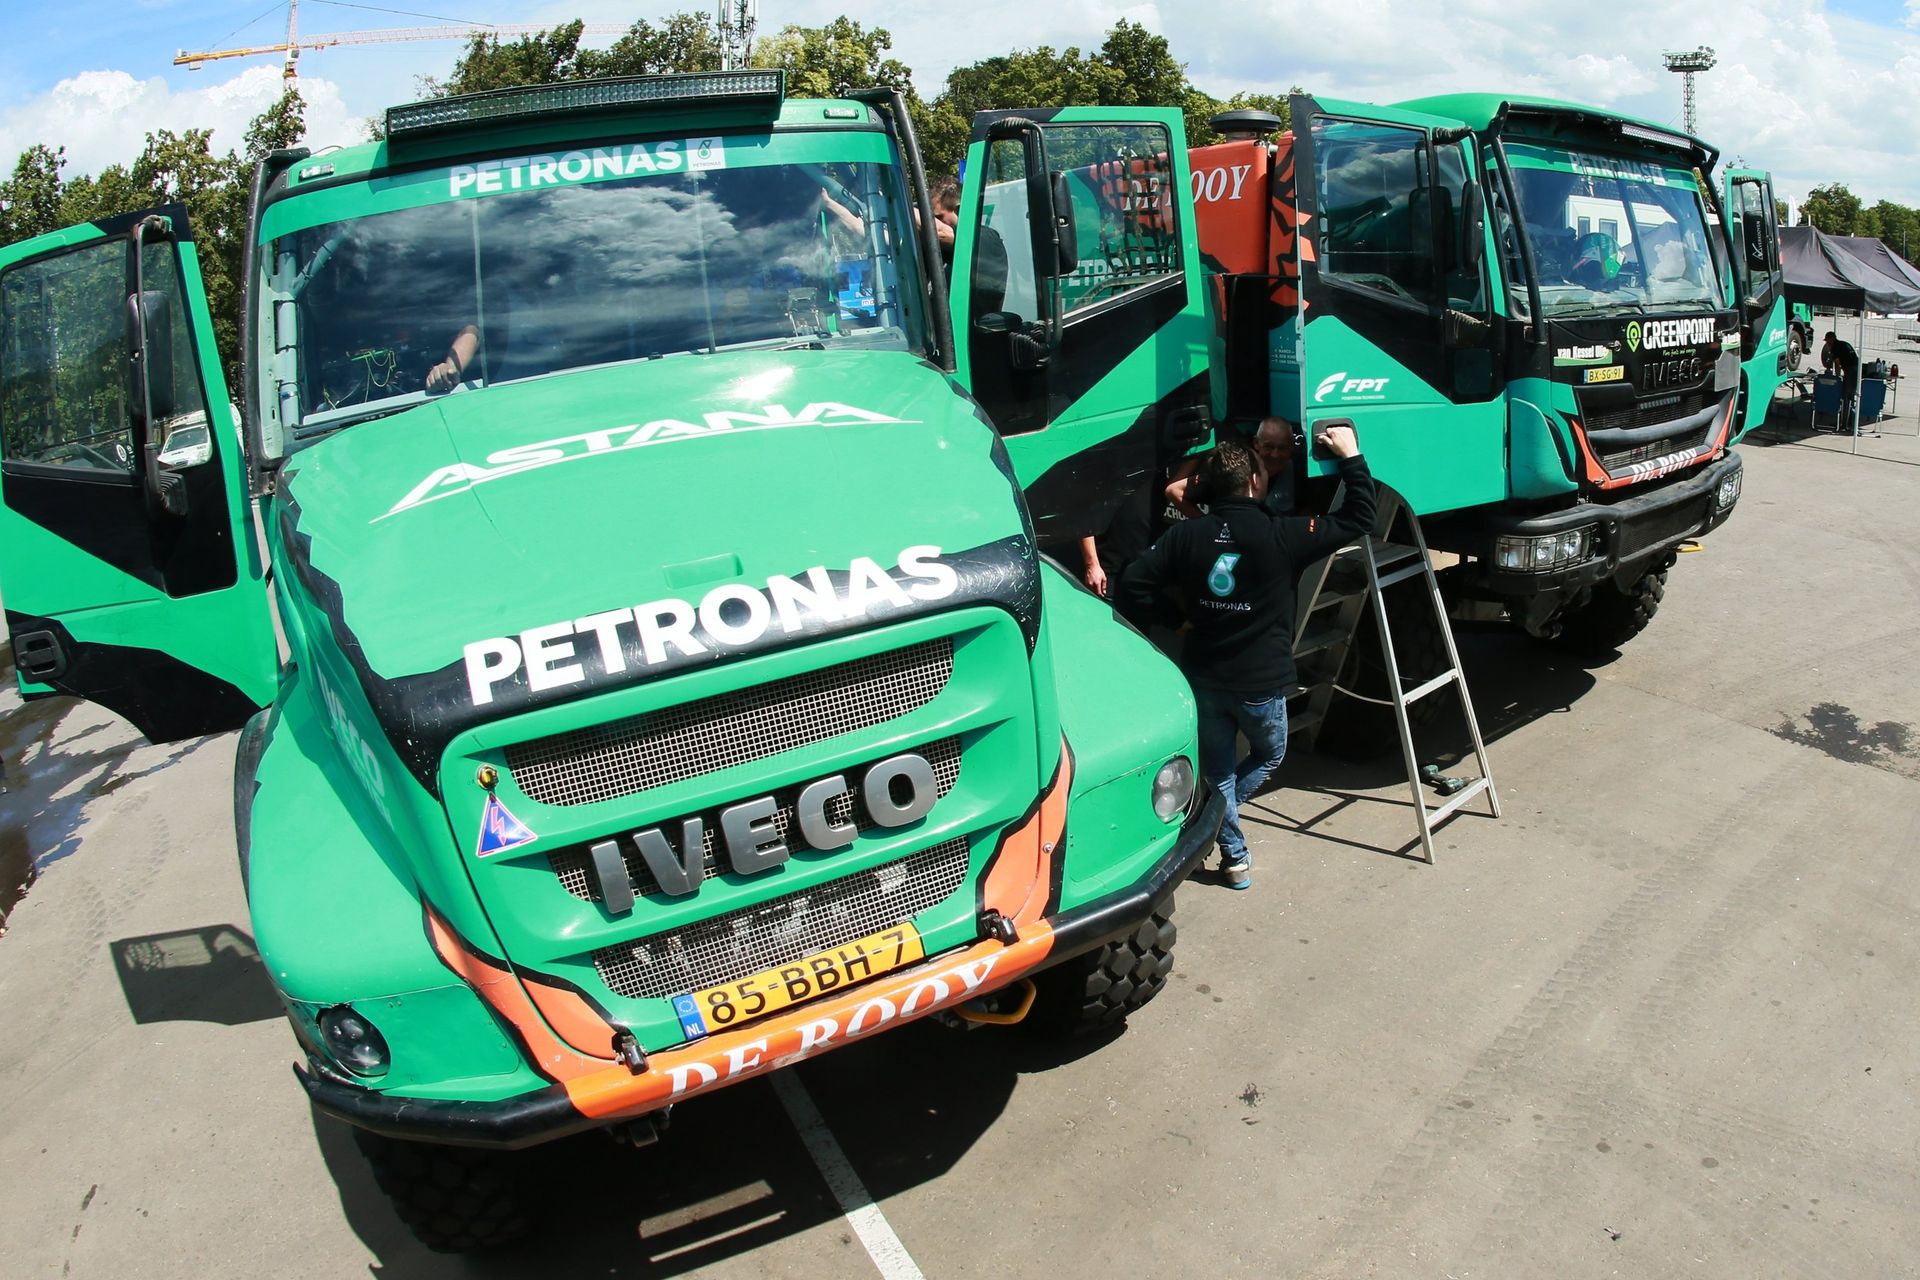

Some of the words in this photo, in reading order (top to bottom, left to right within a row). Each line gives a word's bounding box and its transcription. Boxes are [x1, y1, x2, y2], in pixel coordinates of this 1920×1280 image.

[450, 141, 683, 197] PETRONAS
[1165, 164, 1251, 206] OOY
[1643, 318, 1716, 350] GREENPOINT
[1341, 378, 1390, 393] FPT
[1589, 368, 1621, 381] BX-SG-91
[1643, 357, 1702, 390] IVECO
[384, 401, 908, 515] ASTANA
[463, 545, 959, 706] PETRONAS
[1200, 599, 1252, 611] PETRONAS
[589, 753, 939, 915] IVECO
[707, 930, 905, 1024] 85-BBH-7
[664, 1040, 768, 1099] DE
[796, 956, 1000, 1056] ROOY
[686, 1022, 704, 1037] NL
